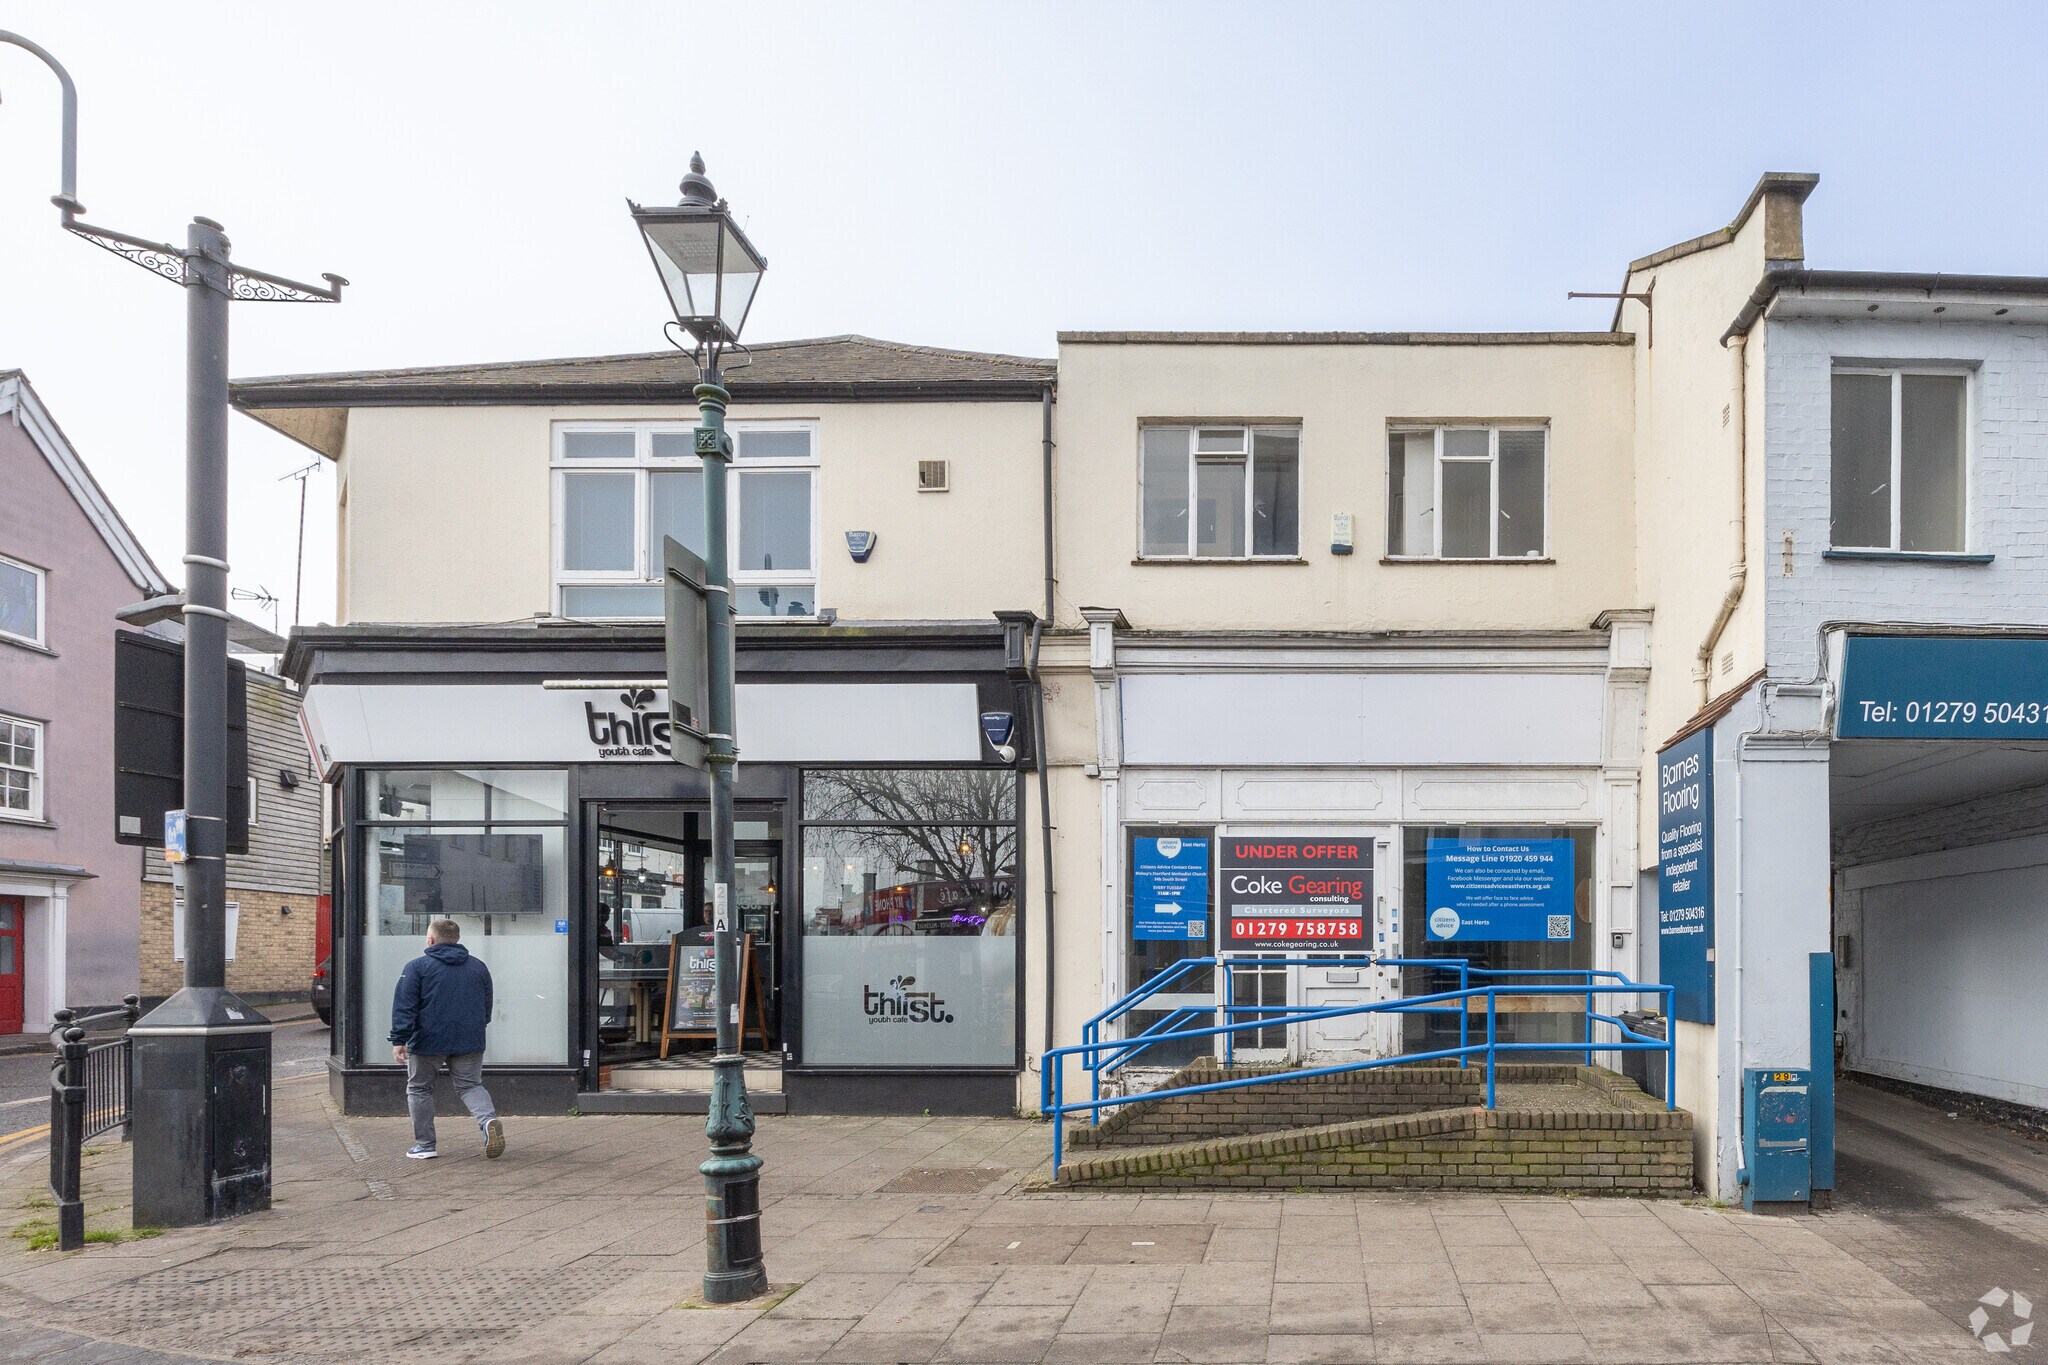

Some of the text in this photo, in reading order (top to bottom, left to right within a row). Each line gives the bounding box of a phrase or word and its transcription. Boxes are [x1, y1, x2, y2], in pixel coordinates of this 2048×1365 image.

[1859, 701, 1898, 722] Tel:
[1906, 702, 1976, 723] 01279
[599, 747, 653, 758] youth cafe
[1663, 754, 1698, 788] Barnes
[1664, 783, 1698, 815] Flooring
[1662, 821, 1702, 843] Quality Flooring
[1235, 845, 1359, 858] UNDER OFFER
[1661, 848, 1673, 861] from
[1678, 838, 1703, 858] specialist
[1446, 855, 1480, 864] Message
[1666, 858, 1698, 877] independent
[1231, 875, 1362, 899] Coke Gearing
[1672, 878, 1691, 893] retailer
[1310, 895, 1349, 903] consulting
[1244, 906, 1350, 916] Chartered Surveyors
[1660, 906, 1705, 923] Tel: 01279 504316
[1236, 923, 1358, 935] 01279 758758
[1254, 941, 1339, 949] www.cokegearing.co.uk
[868, 1016, 891, 1025] youth
